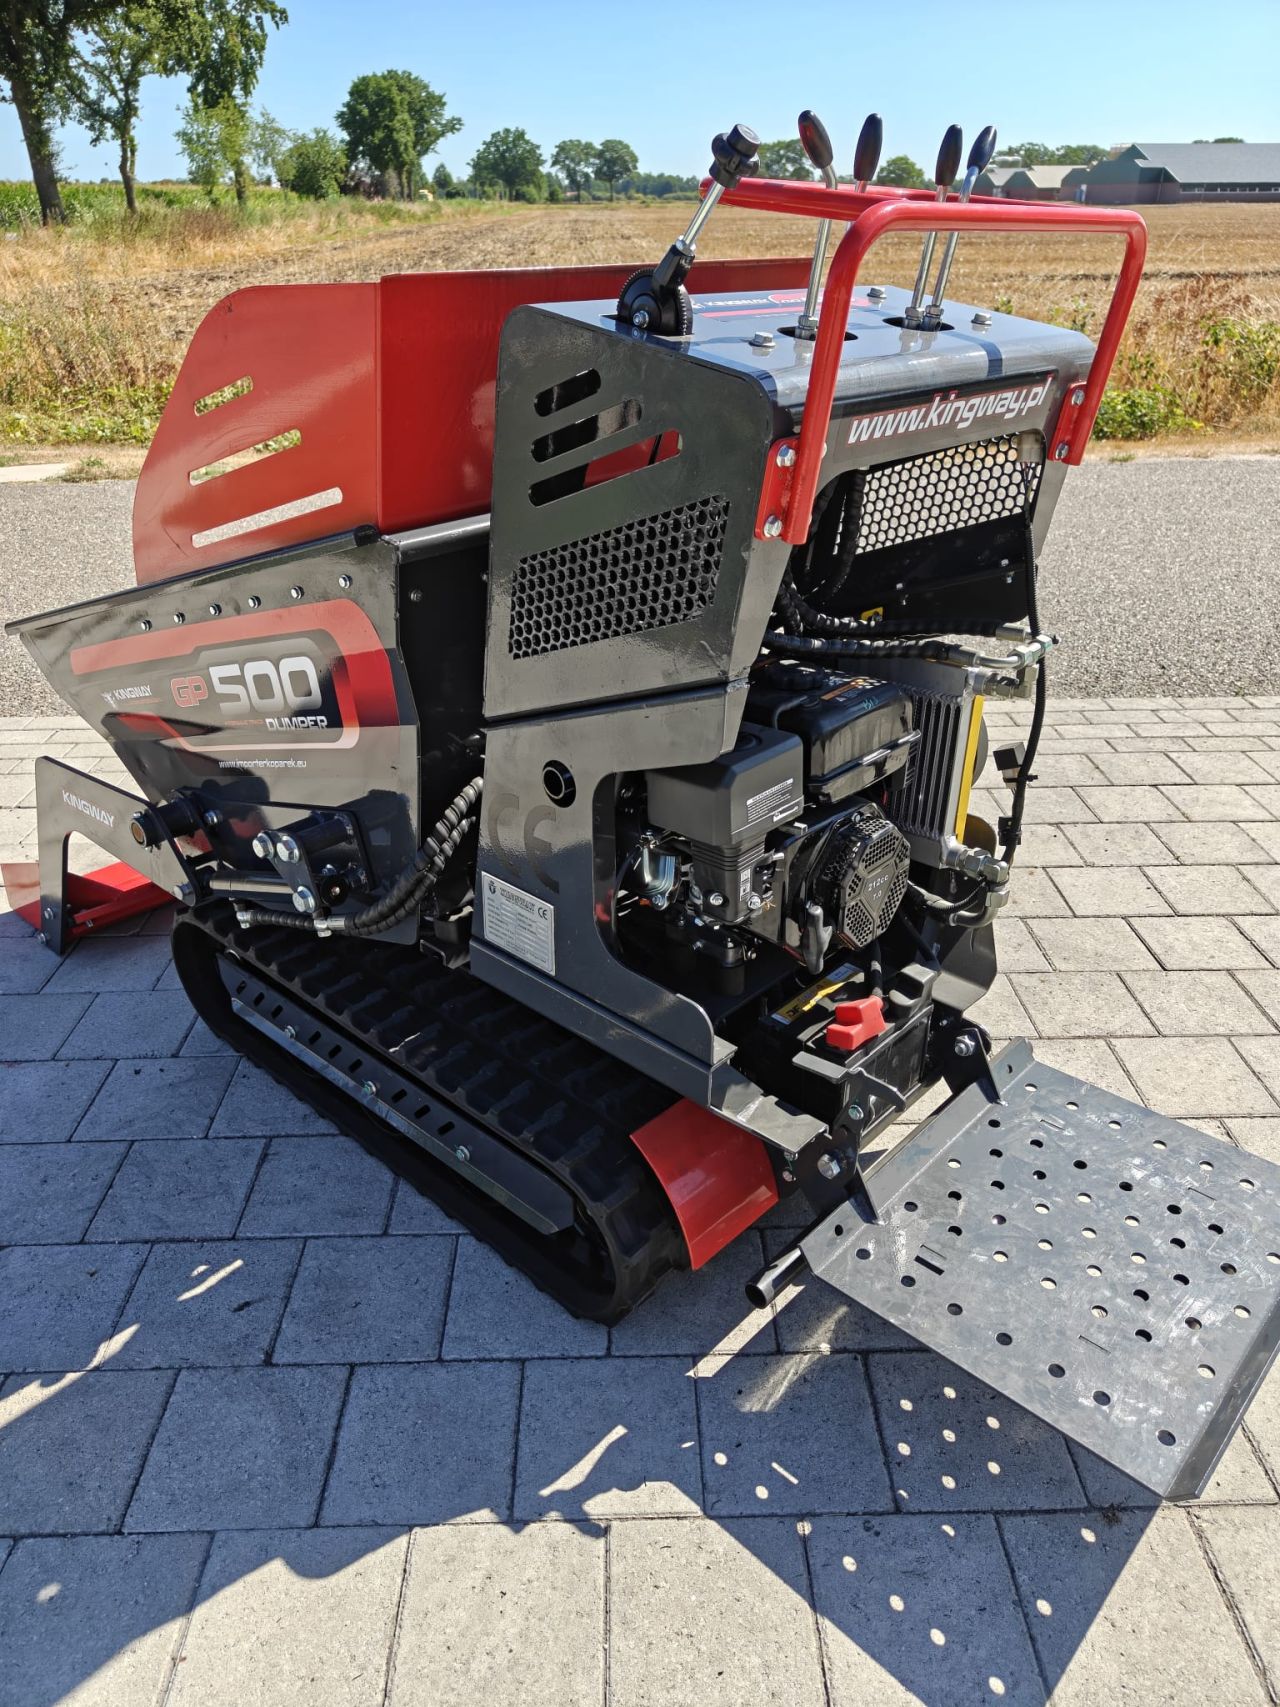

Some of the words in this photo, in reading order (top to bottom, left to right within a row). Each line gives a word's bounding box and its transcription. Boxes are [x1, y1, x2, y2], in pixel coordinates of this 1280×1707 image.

[847, 374, 1055, 444] www.kingway.pl
[113, 684, 152, 700] KINGWAY
[170, 675, 209, 708] GP
[208, 656, 323, 716] 500
[265, 715, 328, 732] DUMPER
[218, 758, 307, 770] www.importerkoparek.eu
[61, 790, 115, 827] KINGWAY
[868, 874, 889, 891] 212cc
